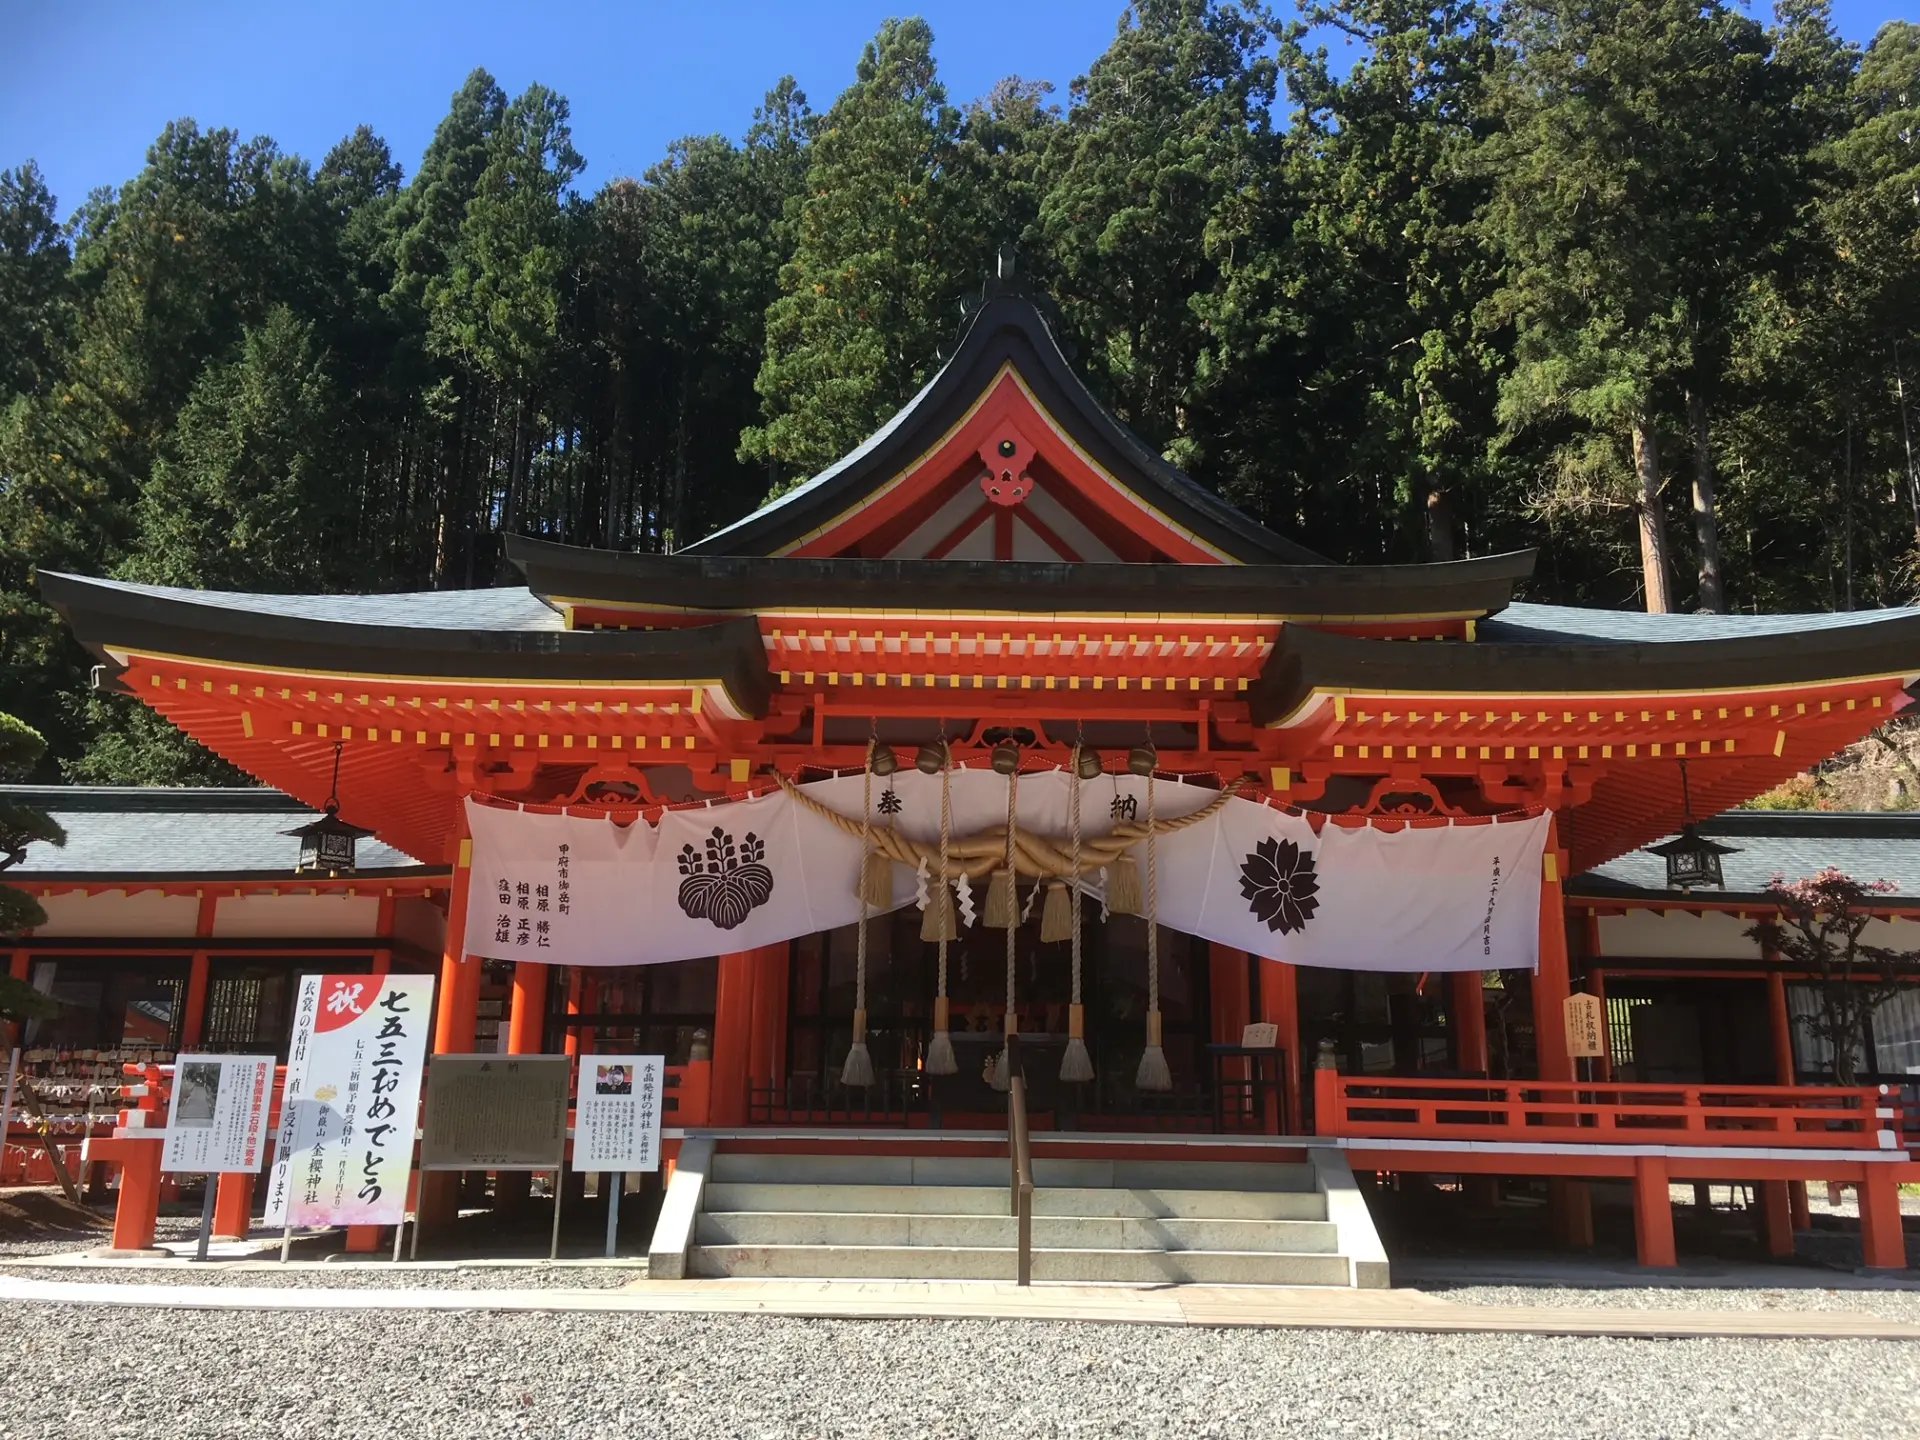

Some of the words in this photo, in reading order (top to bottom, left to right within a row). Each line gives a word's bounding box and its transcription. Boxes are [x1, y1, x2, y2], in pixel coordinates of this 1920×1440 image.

[877, 790, 903, 815] 奉
[1109, 793, 1138, 821] 納
[497, 878, 512, 905] 窪田
[557, 843, 571, 915] 甲府市御岳町
[515, 881, 530, 910] 相原
[535, 884, 550, 912] 相原
[1483, 856, 1501, 955] 平成二十九年四月吉日
[495, 914, 512, 943] 治雄
[516, 918, 531, 946] 正彦
[536, 920, 551, 948] 勝仁
[327, 980, 365, 1014] 祝
[357, 989, 411, 1206] 七五三おめでとう
[303, 1142, 327, 1206] 金櫻神社
